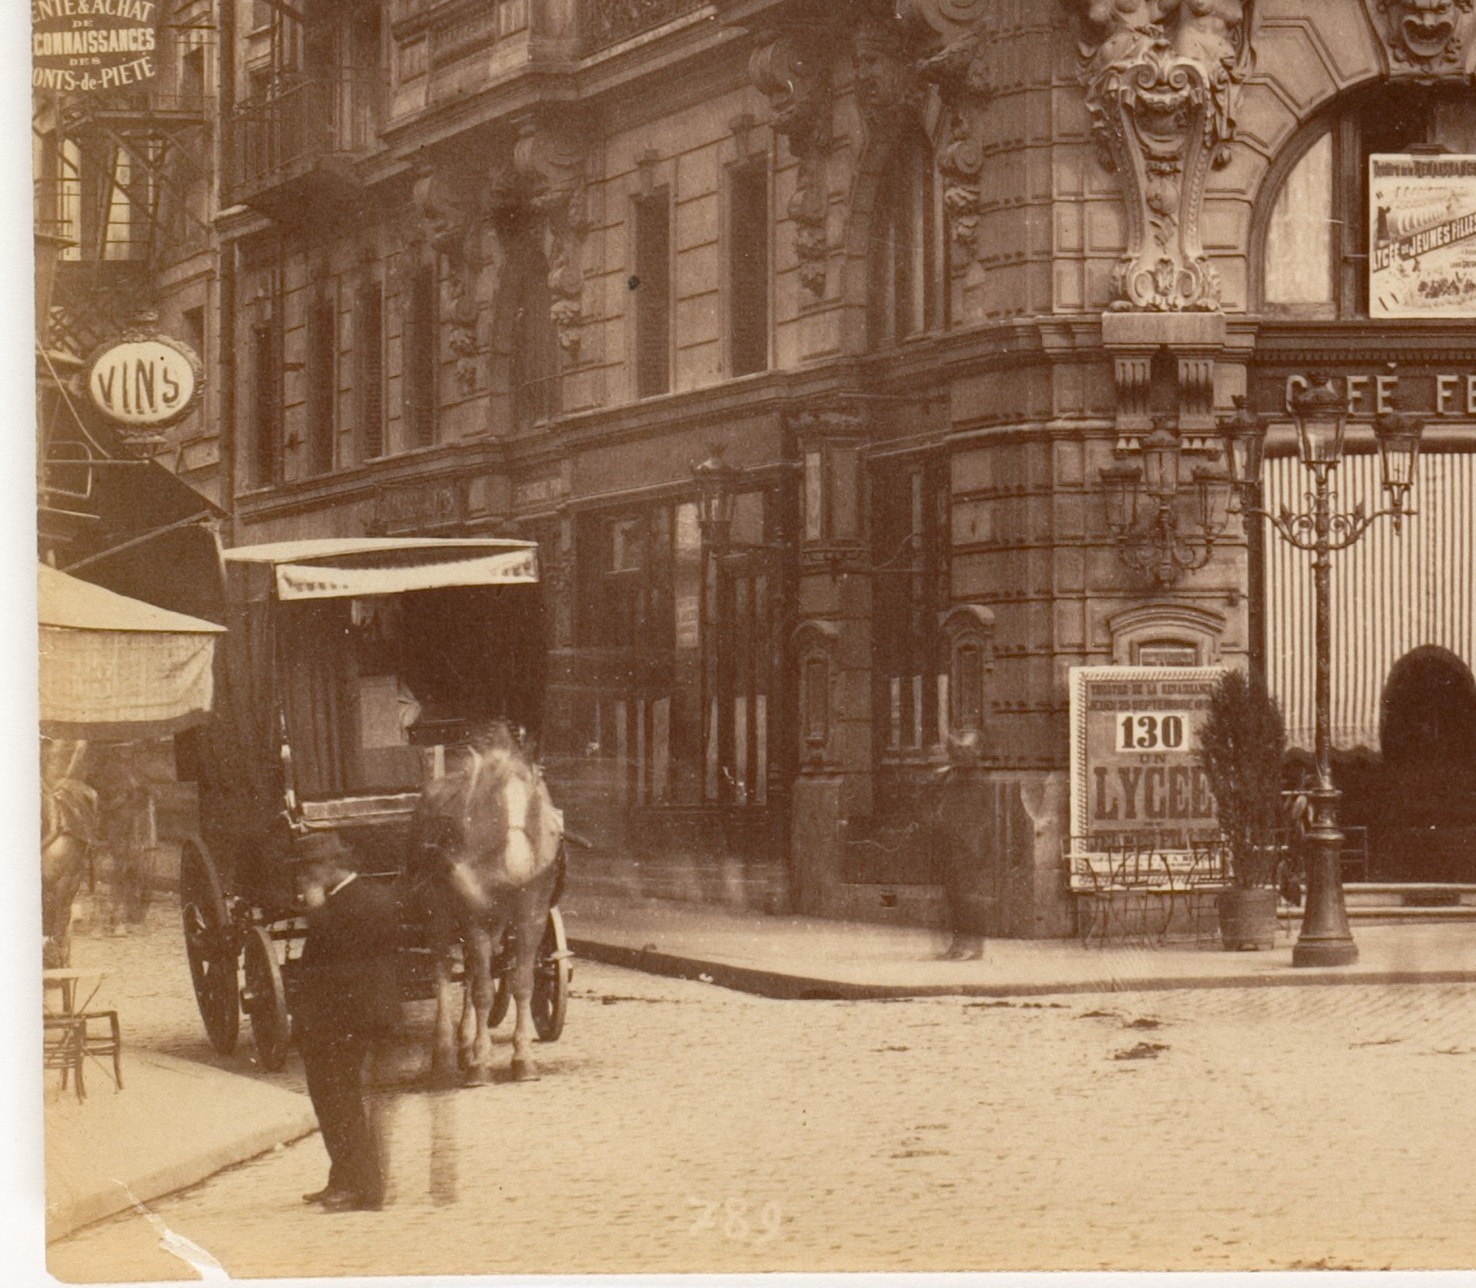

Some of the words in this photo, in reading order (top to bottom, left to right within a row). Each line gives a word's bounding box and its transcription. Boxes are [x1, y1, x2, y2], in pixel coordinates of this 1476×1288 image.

[72, 19, 94, 29] DE
[69, 57, 101, 66] DES
[97, 357, 180, 413] VINS
[1285, 362, 1399, 415] CFÉ
[1120, 715, 1184, 749] 130
[1139, 753, 1167, 765] UN
